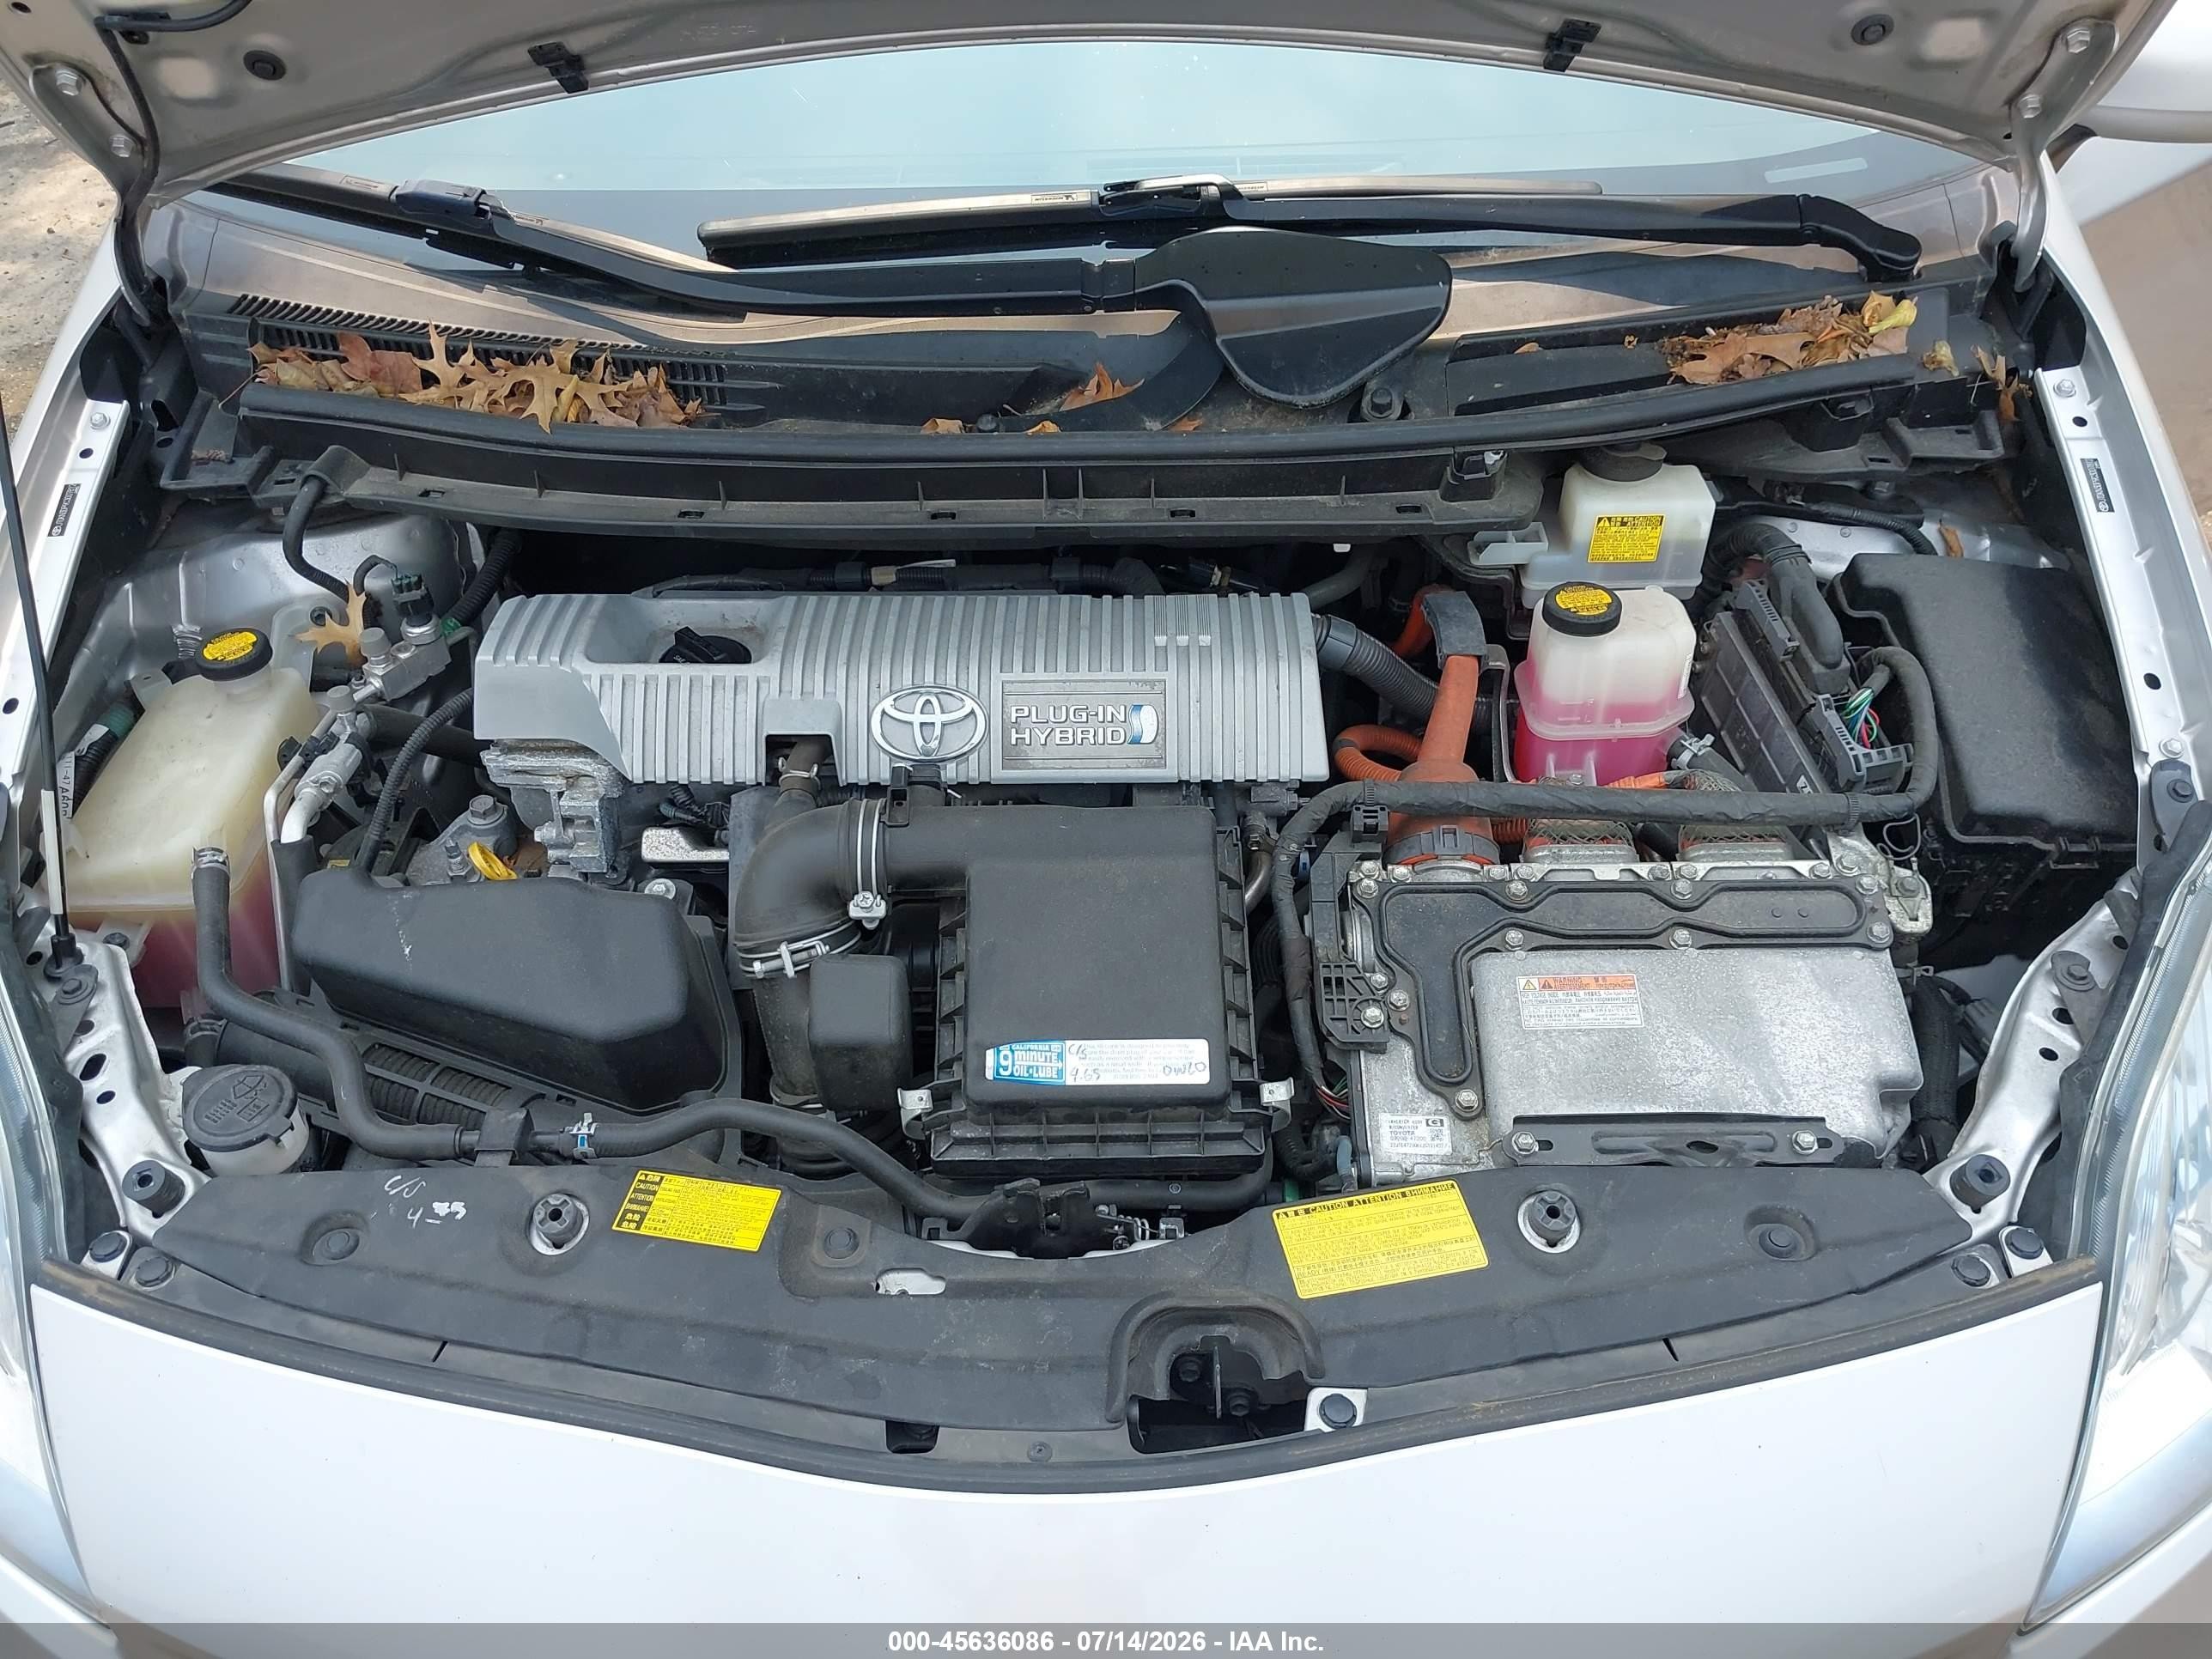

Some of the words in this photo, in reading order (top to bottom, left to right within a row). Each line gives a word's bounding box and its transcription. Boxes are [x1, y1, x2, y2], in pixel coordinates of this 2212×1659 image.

[1011, 705, 1127, 724] PLUG-IN
[1011, 726, 1127, 746] HYBRID
[999, 1050, 1012, 1076] 9
[635, 1182, 660, 1191] CAUTION
[630, 1192, 656, 1202] ATTENTION
[1310, 1201, 1349, 1213] CAUTION
[1352, 1192, 1402, 1206] ATTENTION
[1407, 1183, 1455, 1197] ВНИМАНИЕ
